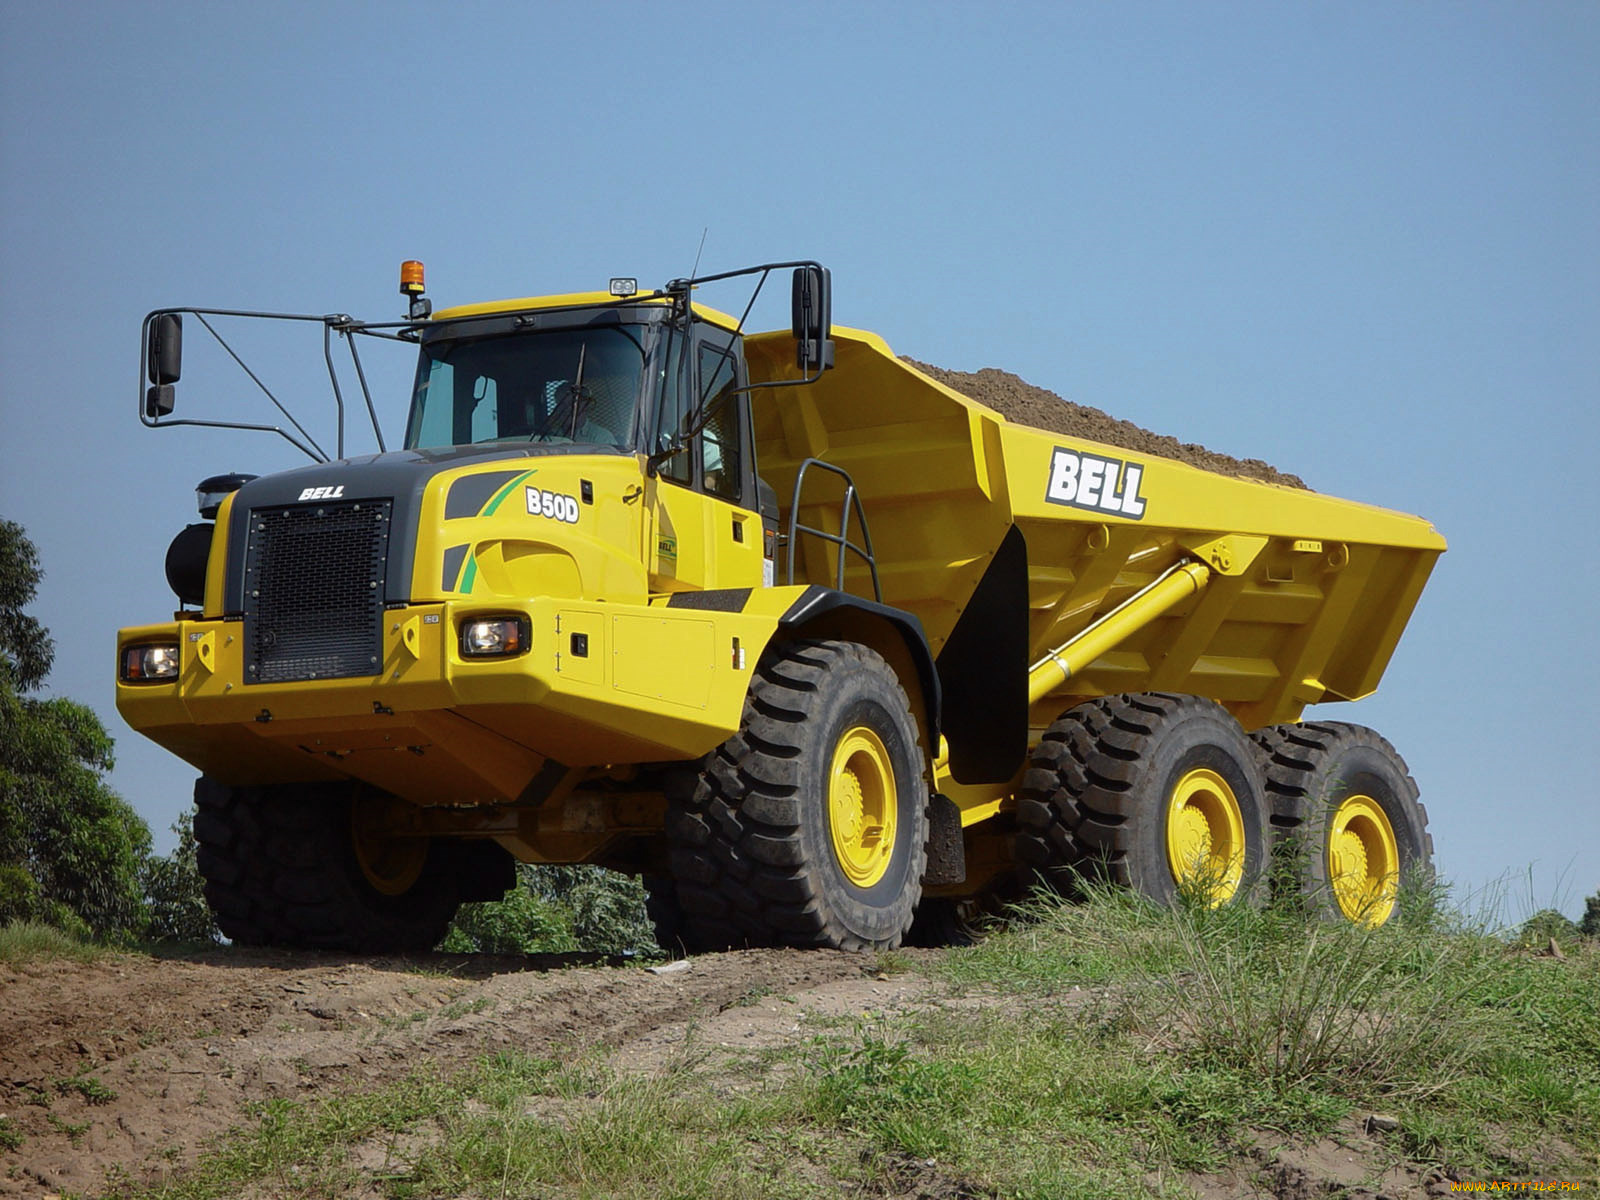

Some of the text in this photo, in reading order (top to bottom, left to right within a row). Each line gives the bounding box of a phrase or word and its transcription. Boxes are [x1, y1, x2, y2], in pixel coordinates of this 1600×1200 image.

[298, 485, 345, 501] BELL
[1046, 447, 1146, 519] BELL
[525, 486, 579, 524] B50D
